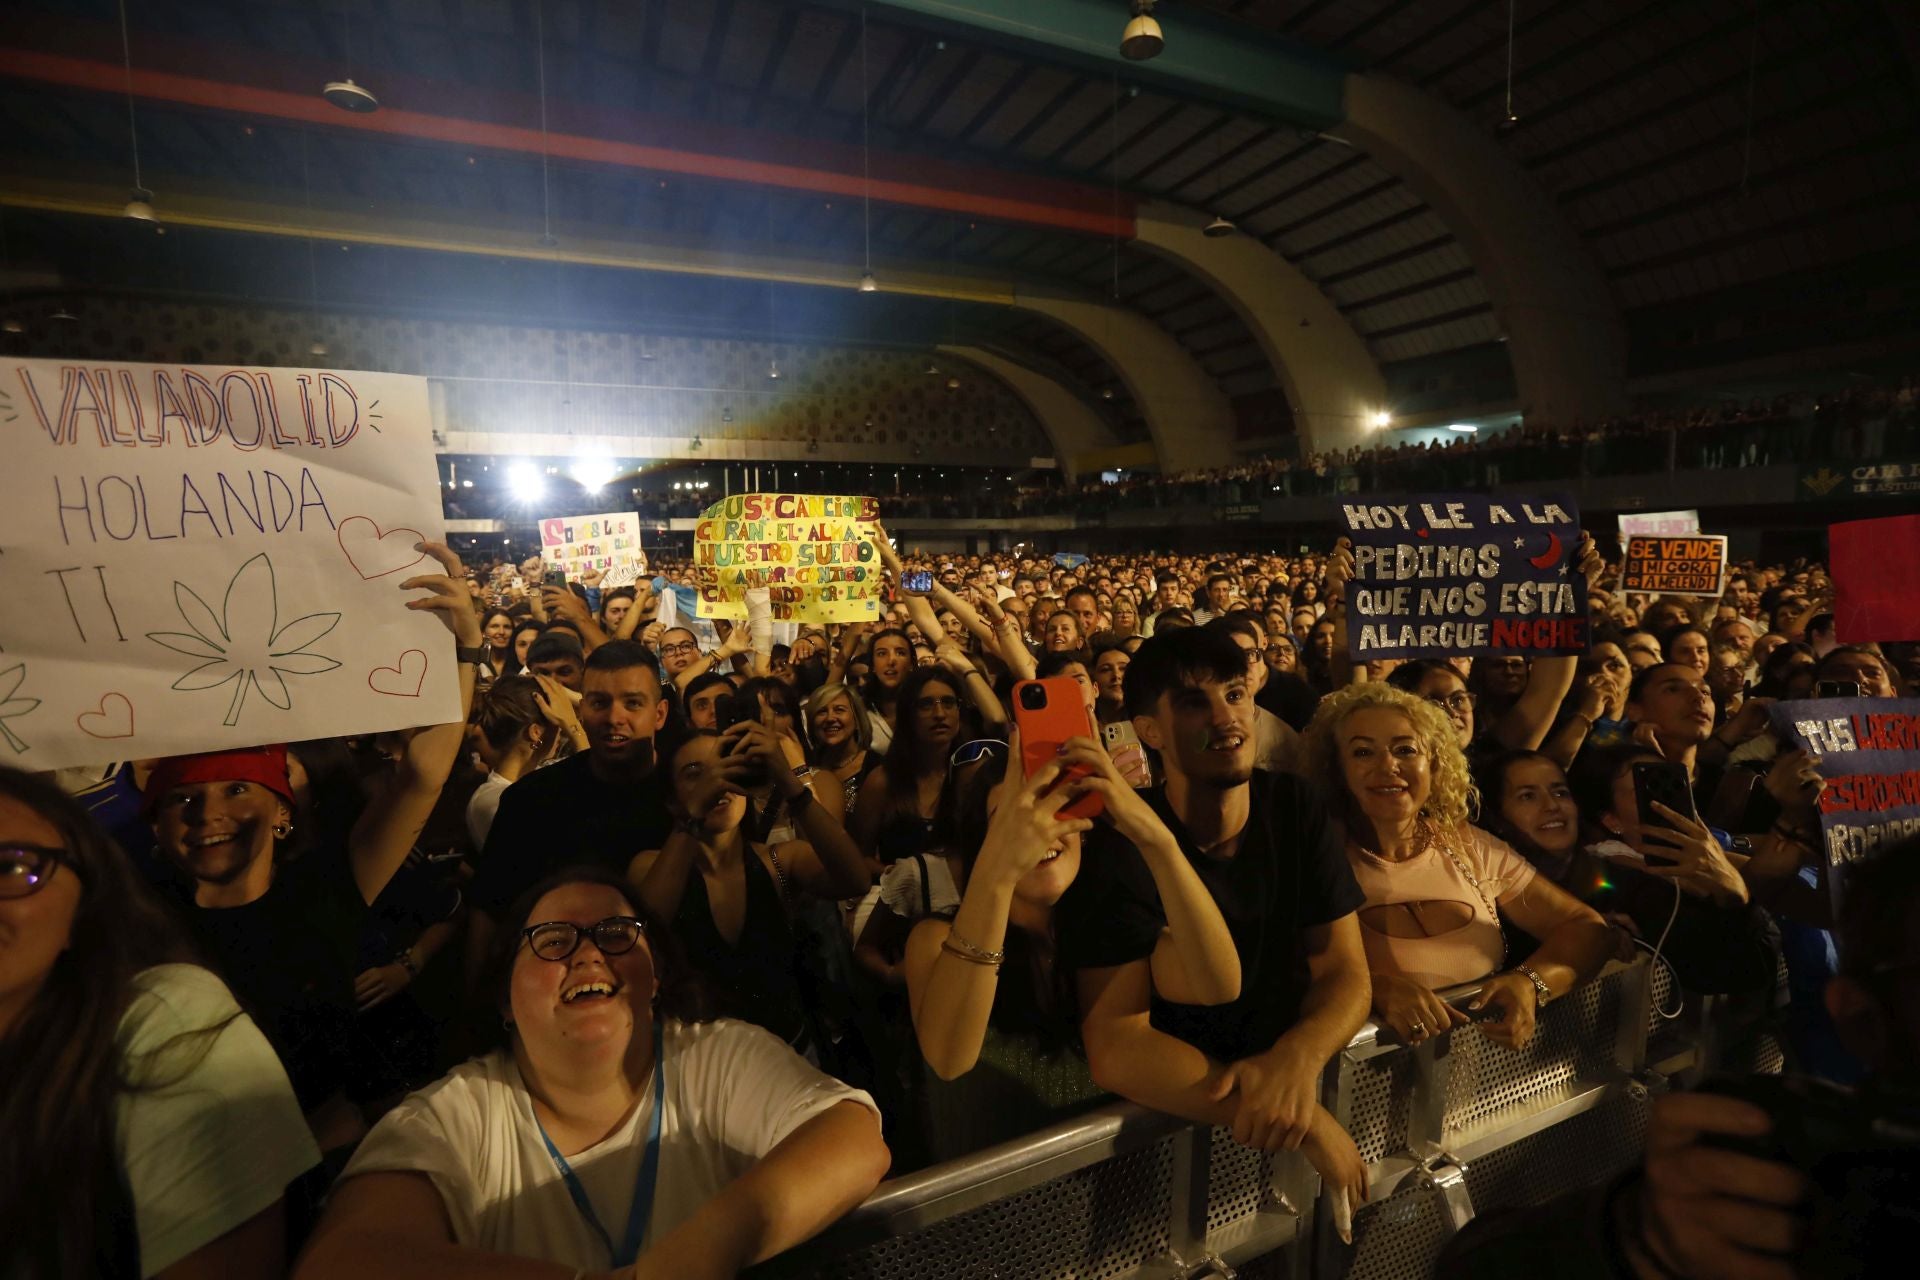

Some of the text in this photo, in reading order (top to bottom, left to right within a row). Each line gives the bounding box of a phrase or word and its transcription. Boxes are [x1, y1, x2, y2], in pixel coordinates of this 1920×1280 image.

[17, 366, 359, 451] VALLADOLID
[54, 467, 336, 545] HOLANDA
[1343, 503, 1573, 529] HOY LE A LA
[604, 519, 626, 537] LS
[696, 521, 764, 541] CURAN
[777, 523, 799, 541] EL
[700, 543, 792, 567] NUESTRO
[1355, 544, 1500, 580] PEDIMOS
[1630, 540, 1723, 560] SE VENDE
[596, 556, 612, 569] EN
[1647, 561, 1712, 574] MI CORA
[796, 566, 867, 584] CONTIGO
[1645, 576, 1711, 589] A MELENDI
[45, 565, 128, 643] TI
[812, 585, 838, 602] POR
[847, 585, 868, 600] LA
[1356, 581, 1576, 617] QUE NOS ESTA
[1359, 618, 1586, 650] ALARGUE NOCHE
[1796, 717, 1856, 755] TUS
